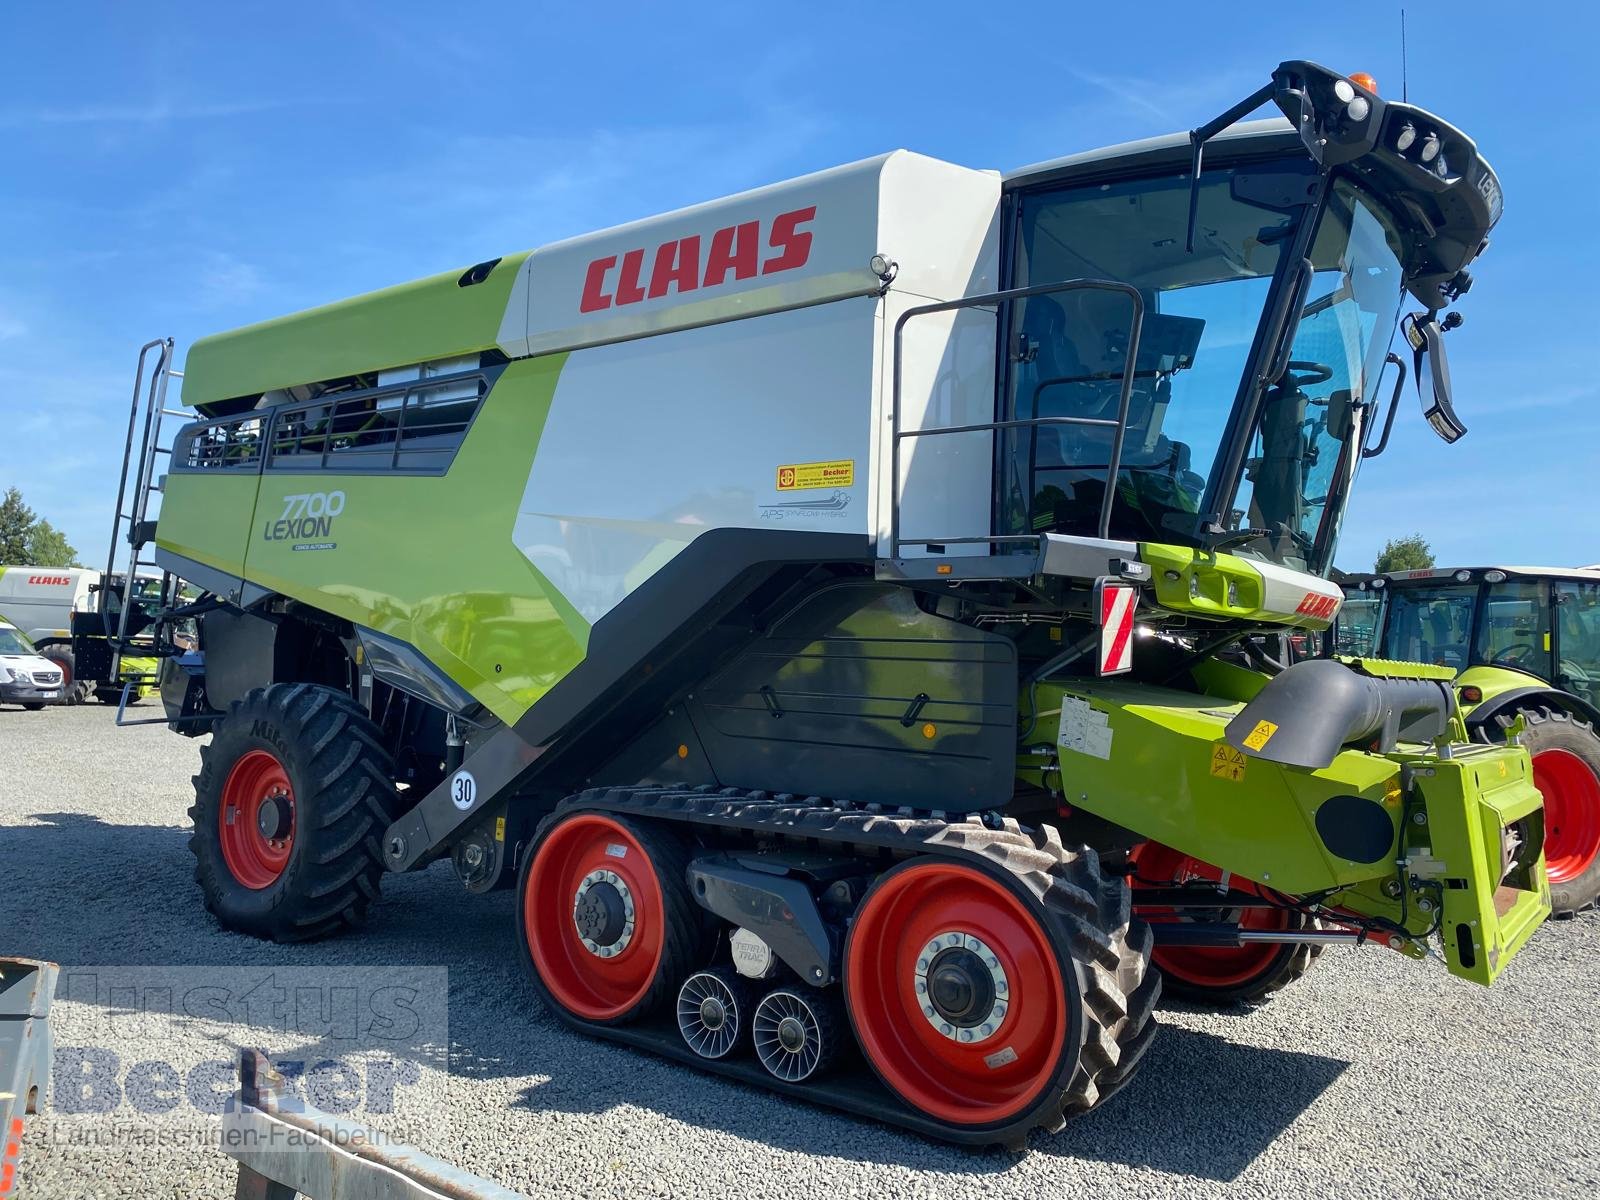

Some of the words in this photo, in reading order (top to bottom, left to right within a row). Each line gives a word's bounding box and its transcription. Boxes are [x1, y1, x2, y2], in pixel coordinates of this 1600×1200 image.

[580, 205, 817, 313] CLAAS
[823, 469, 849, 477] Becker
[280, 490, 345, 520] 7700
[760, 510, 784, 520] APS
[264, 516, 332, 541] LEXION
[28, 576, 70, 585] CLAAS
[1408, 570, 1433, 579] CLAAS
[1296, 592, 1339, 618] CLAAS
[455, 778, 471, 802] 30
[736, 941, 766, 953] TERRA
[739, 950, 764, 962] TRAC
